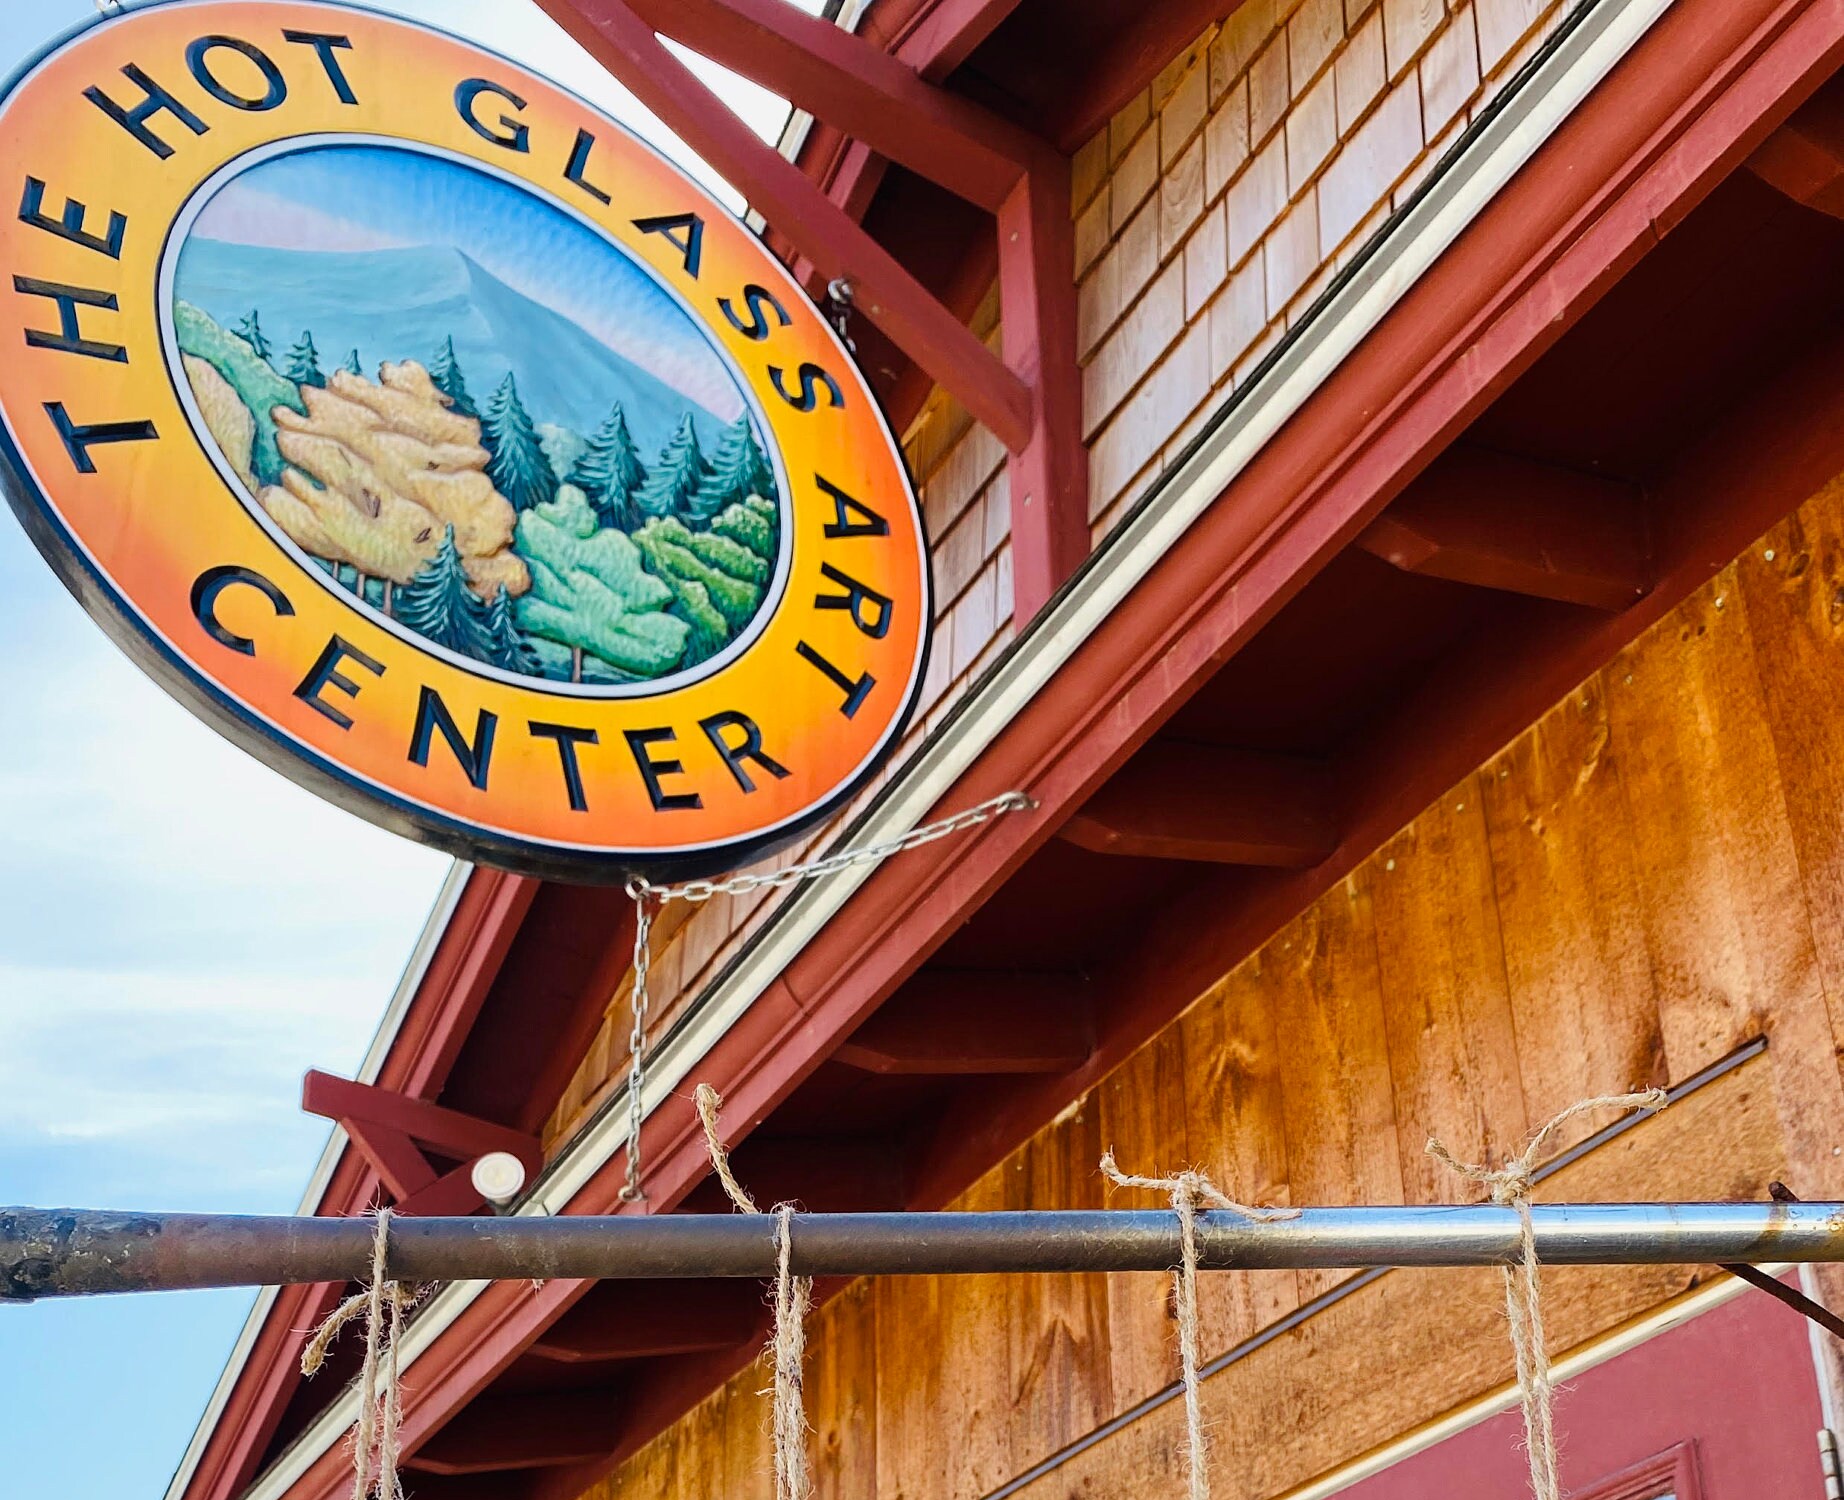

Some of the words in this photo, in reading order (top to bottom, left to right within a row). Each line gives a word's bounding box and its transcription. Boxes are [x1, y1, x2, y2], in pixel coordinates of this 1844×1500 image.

[82, 28, 359, 160] HOT
[13, 175, 159, 474] THE
[452, 77, 845, 416] GLASS
[189, 565, 791, 813] CENTER
[796, 473, 895, 720] ART
